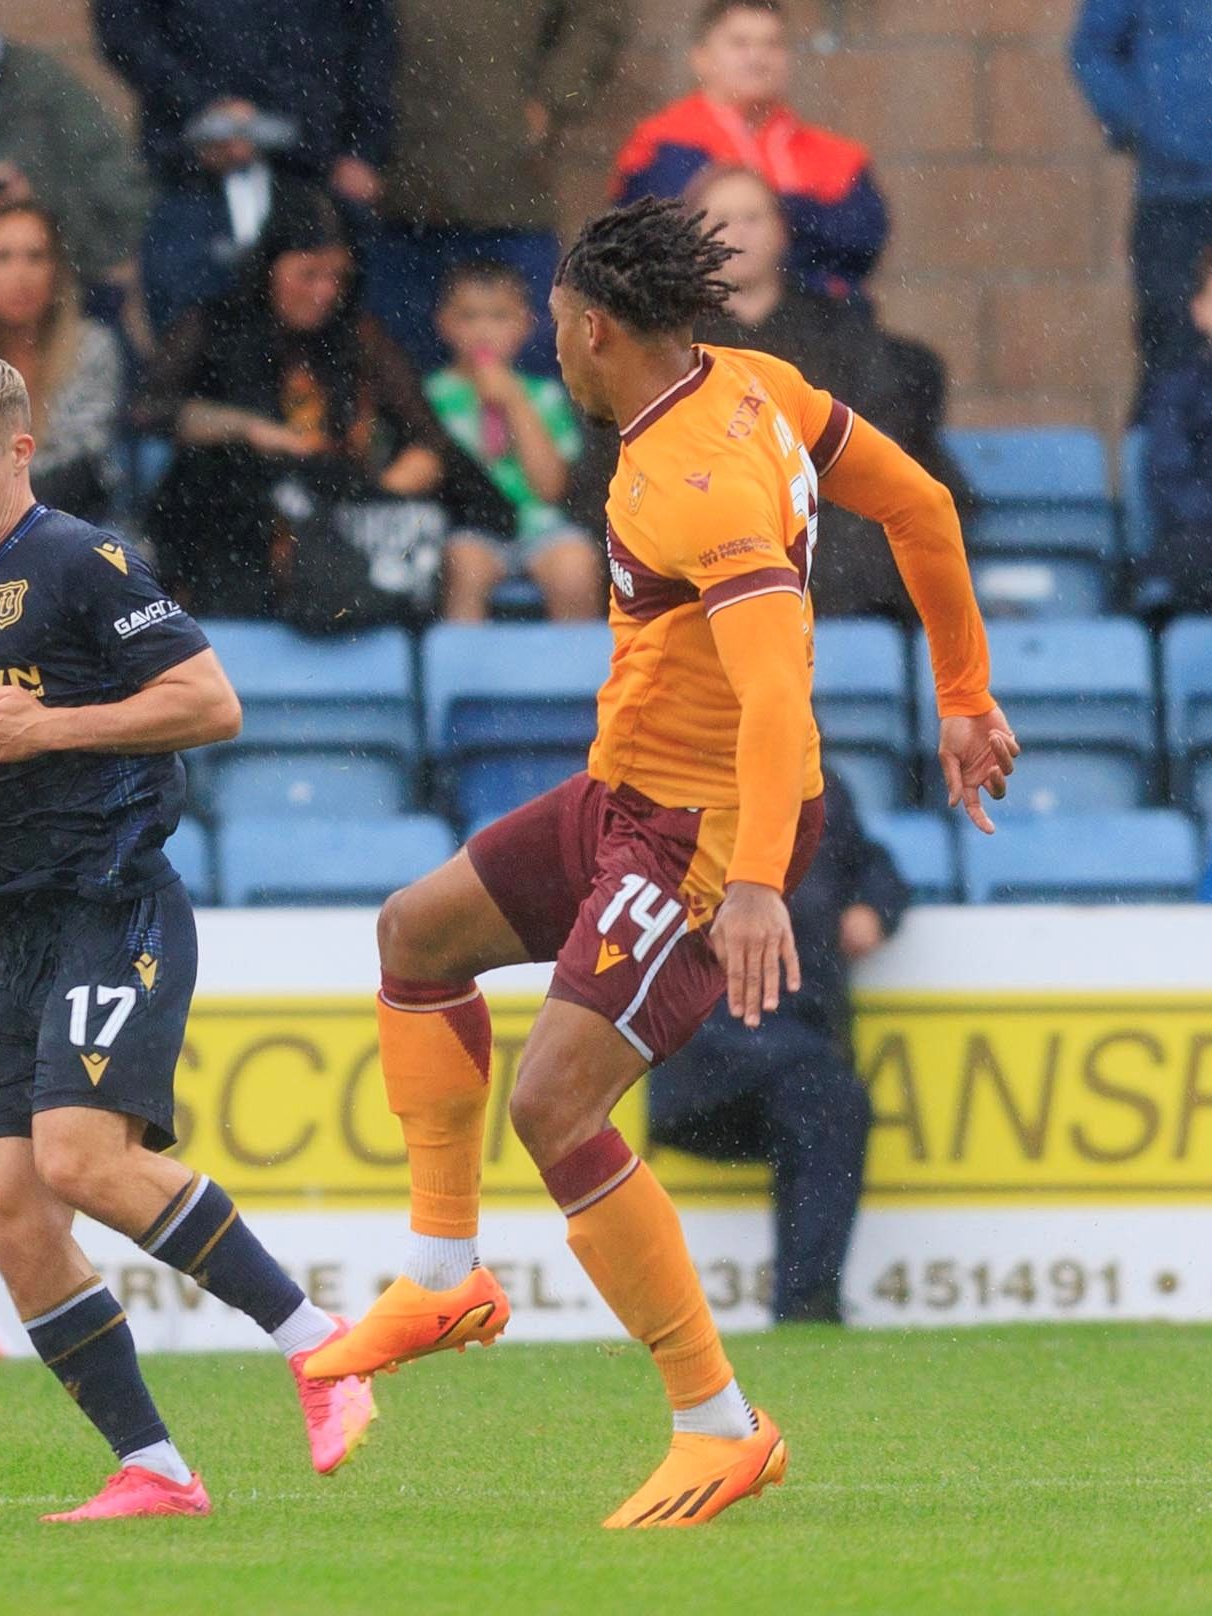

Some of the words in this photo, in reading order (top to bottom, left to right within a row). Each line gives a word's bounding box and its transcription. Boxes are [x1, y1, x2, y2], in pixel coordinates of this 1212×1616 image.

[597, 873, 683, 963] 14
[65, 984, 137, 1048] 17
[872, 1258, 1121, 1312] 451491
